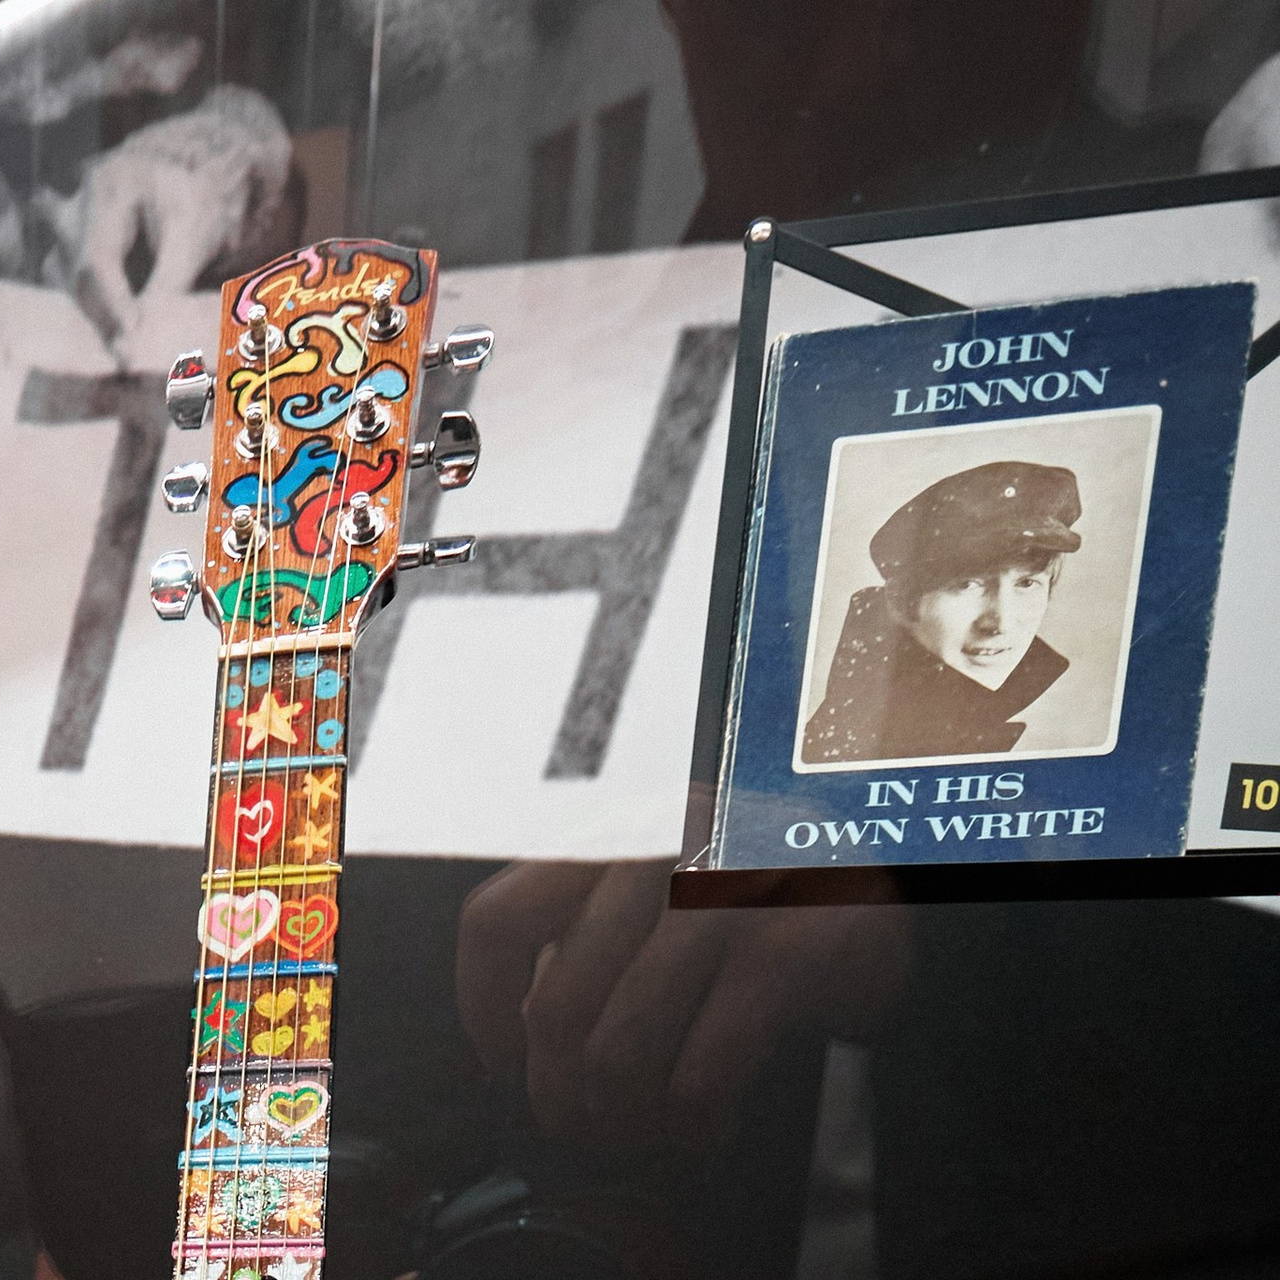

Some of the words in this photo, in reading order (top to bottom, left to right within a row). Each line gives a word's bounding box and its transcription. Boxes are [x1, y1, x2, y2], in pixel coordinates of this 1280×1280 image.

[932, 328, 1075, 373] JOHN
[890, 366, 1112, 418] LENNON
[864, 778, 920, 807] IN
[931, 771, 1026, 805] HIS
[1241, 778, 1280, 811] 10
[783, 817, 911, 850] OWN
[923, 806, 1106, 842] WRITE
